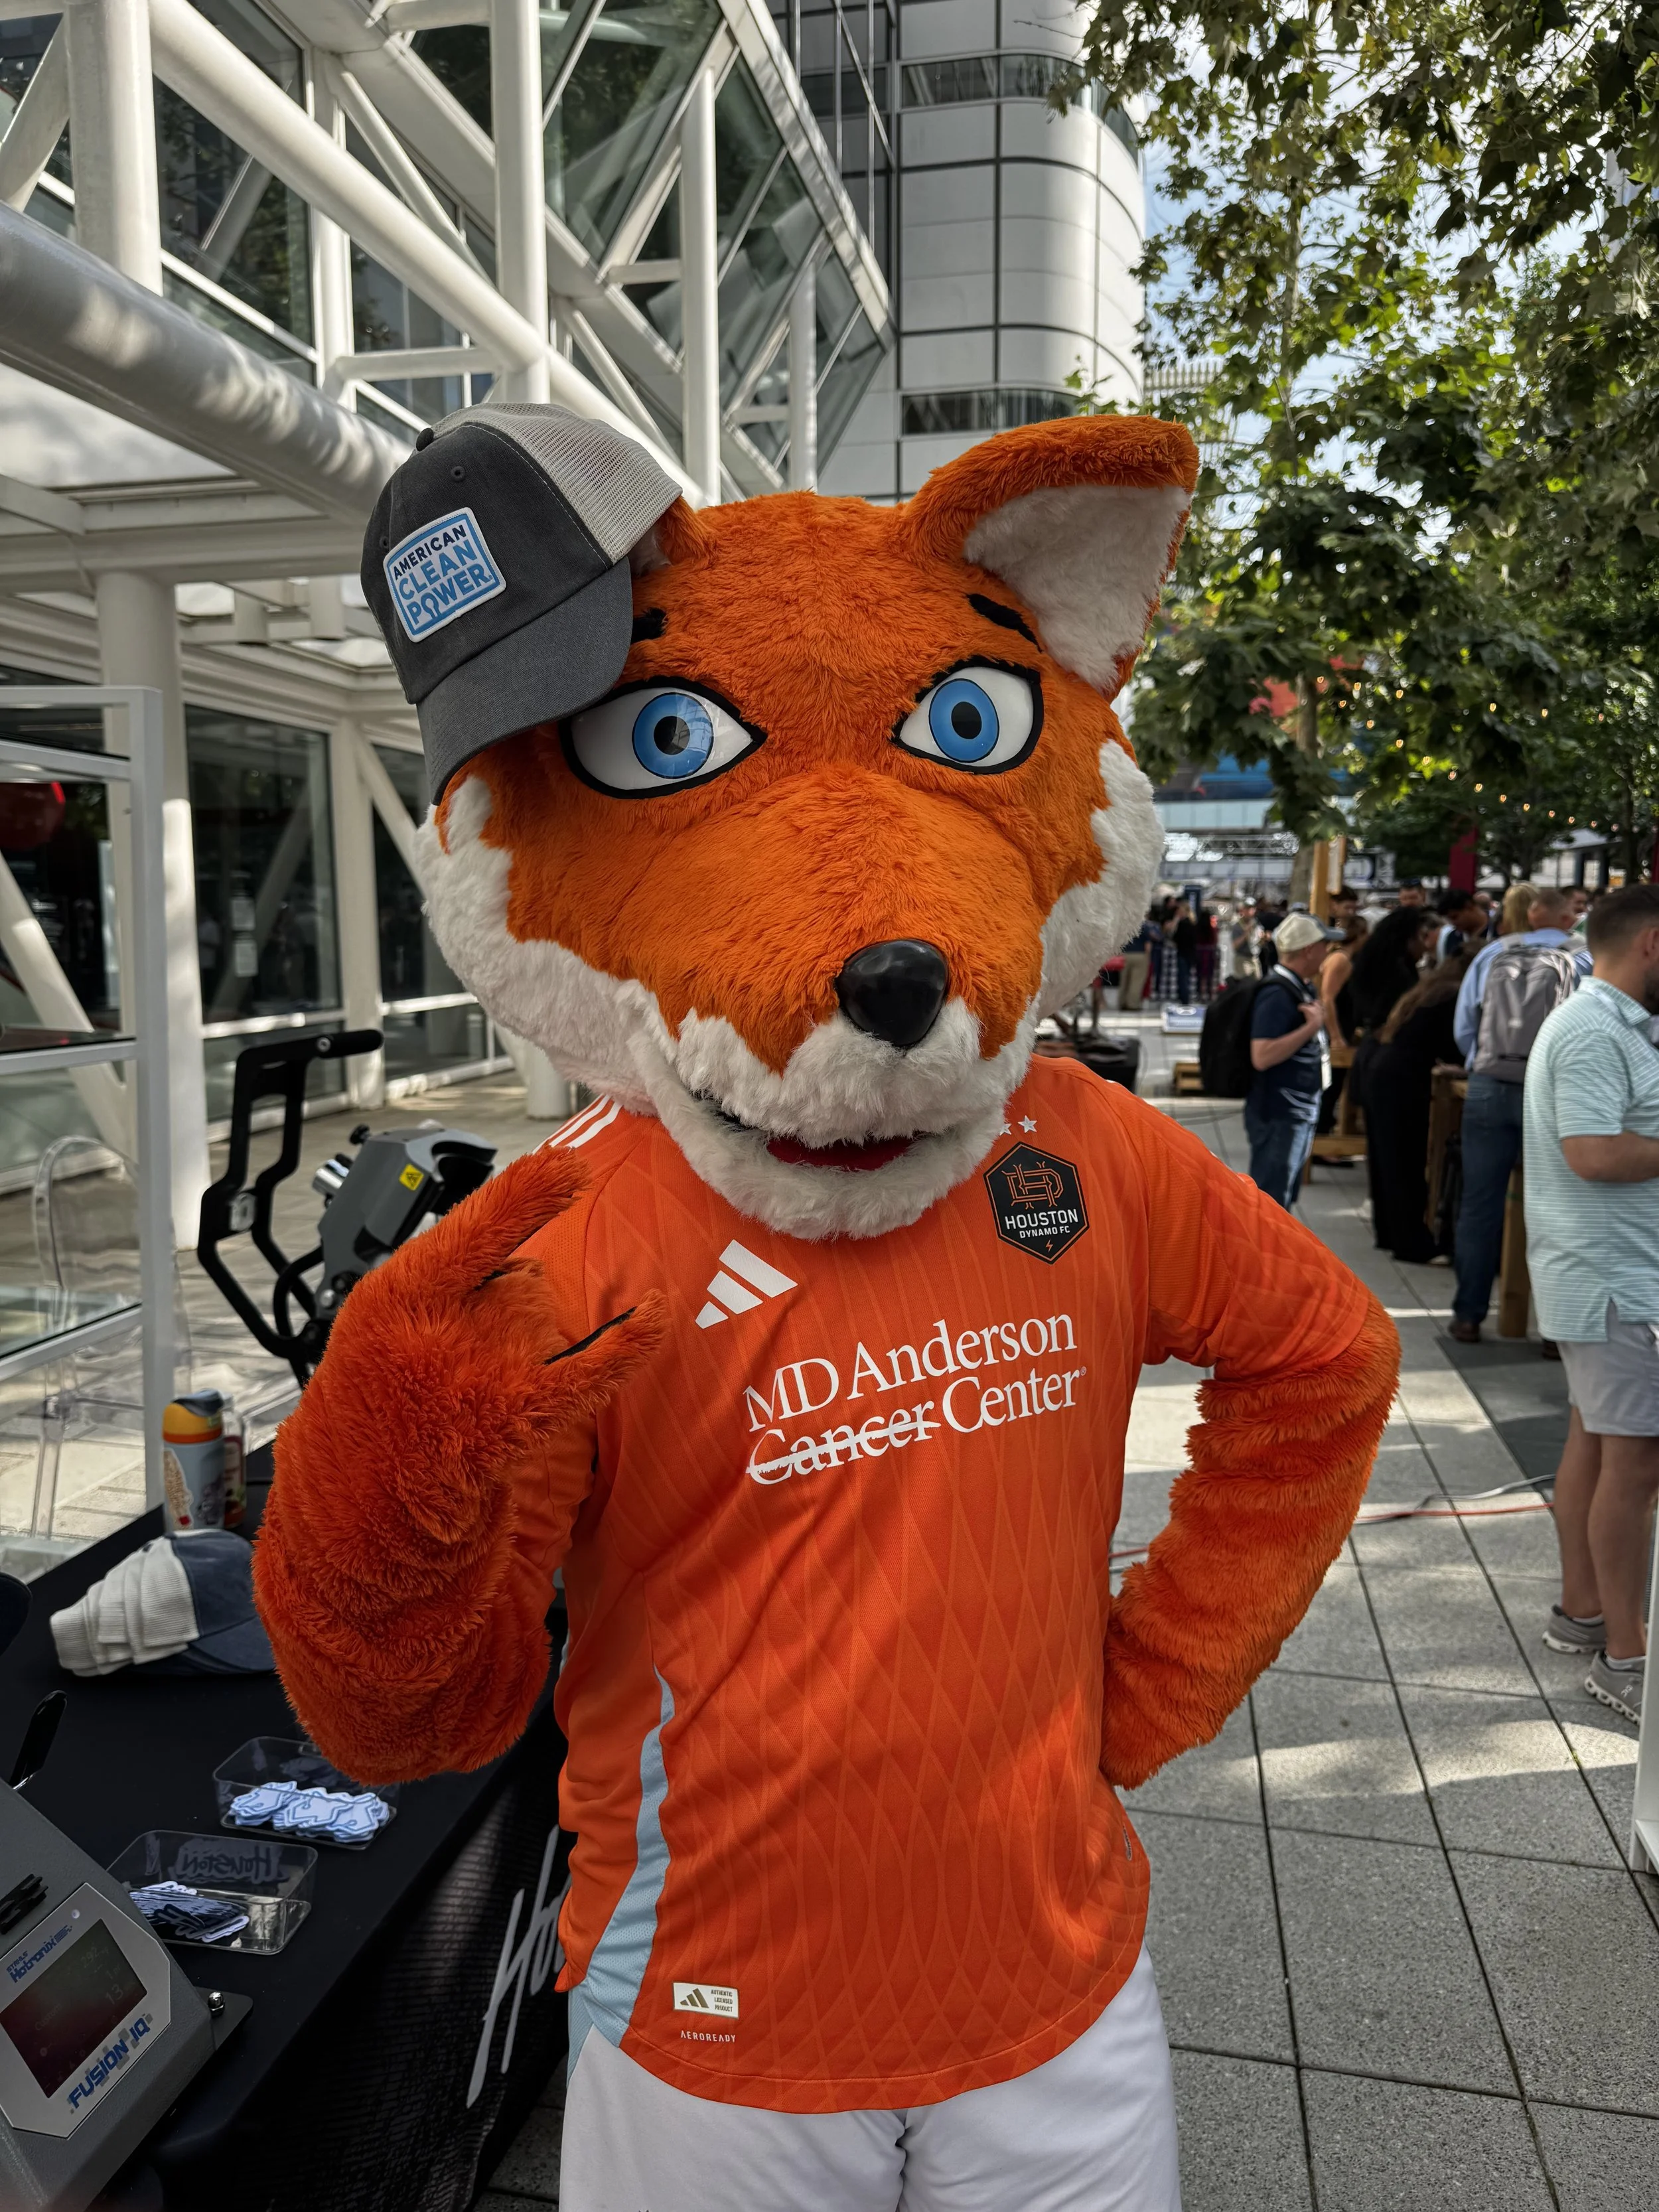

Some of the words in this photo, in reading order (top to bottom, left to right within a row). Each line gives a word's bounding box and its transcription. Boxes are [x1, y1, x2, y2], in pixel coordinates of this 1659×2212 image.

[394, 524, 467, 581] AMERICAN
[399, 540, 478, 600] CLEAN
[1005, 1209, 1078, 1230] HOUSTON
[1019, 1227, 1058, 1238] DYNAMO
[1060, 1226, 1070, 1234] FC
[743, 1358, 839, 1432] MD
[847, 1313, 1077, 1400] Anderson
[747, 1401, 936, 1485] Cancer
[68, 2038, 129, 2108] FUSION
[129, 2017, 151, 2042] IQ
[680, 2030, 736, 2043] AEROREADY
